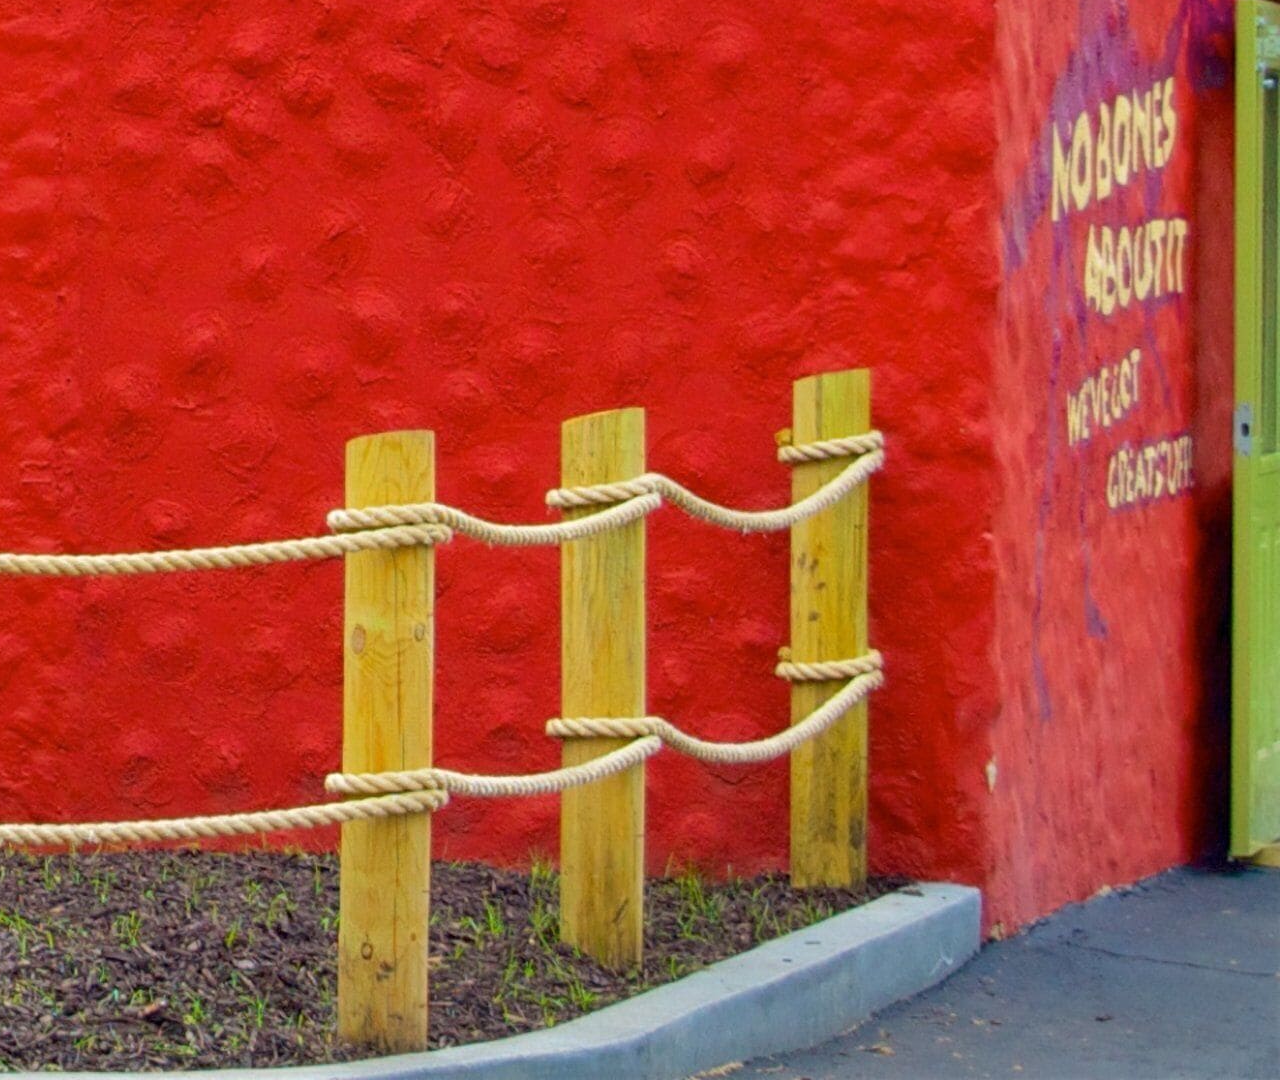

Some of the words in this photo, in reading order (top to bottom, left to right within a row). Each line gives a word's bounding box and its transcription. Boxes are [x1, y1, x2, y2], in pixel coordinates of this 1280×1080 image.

[1051, 109, 1092, 222] NO
[1096, 76, 1178, 201] BONES
[1084, 219, 1166, 316] ABOUT
[1166, 218, 1188, 295] IT
[1111, 347, 1141, 419] GOT
[1106, 446, 1157, 509] GREAT
